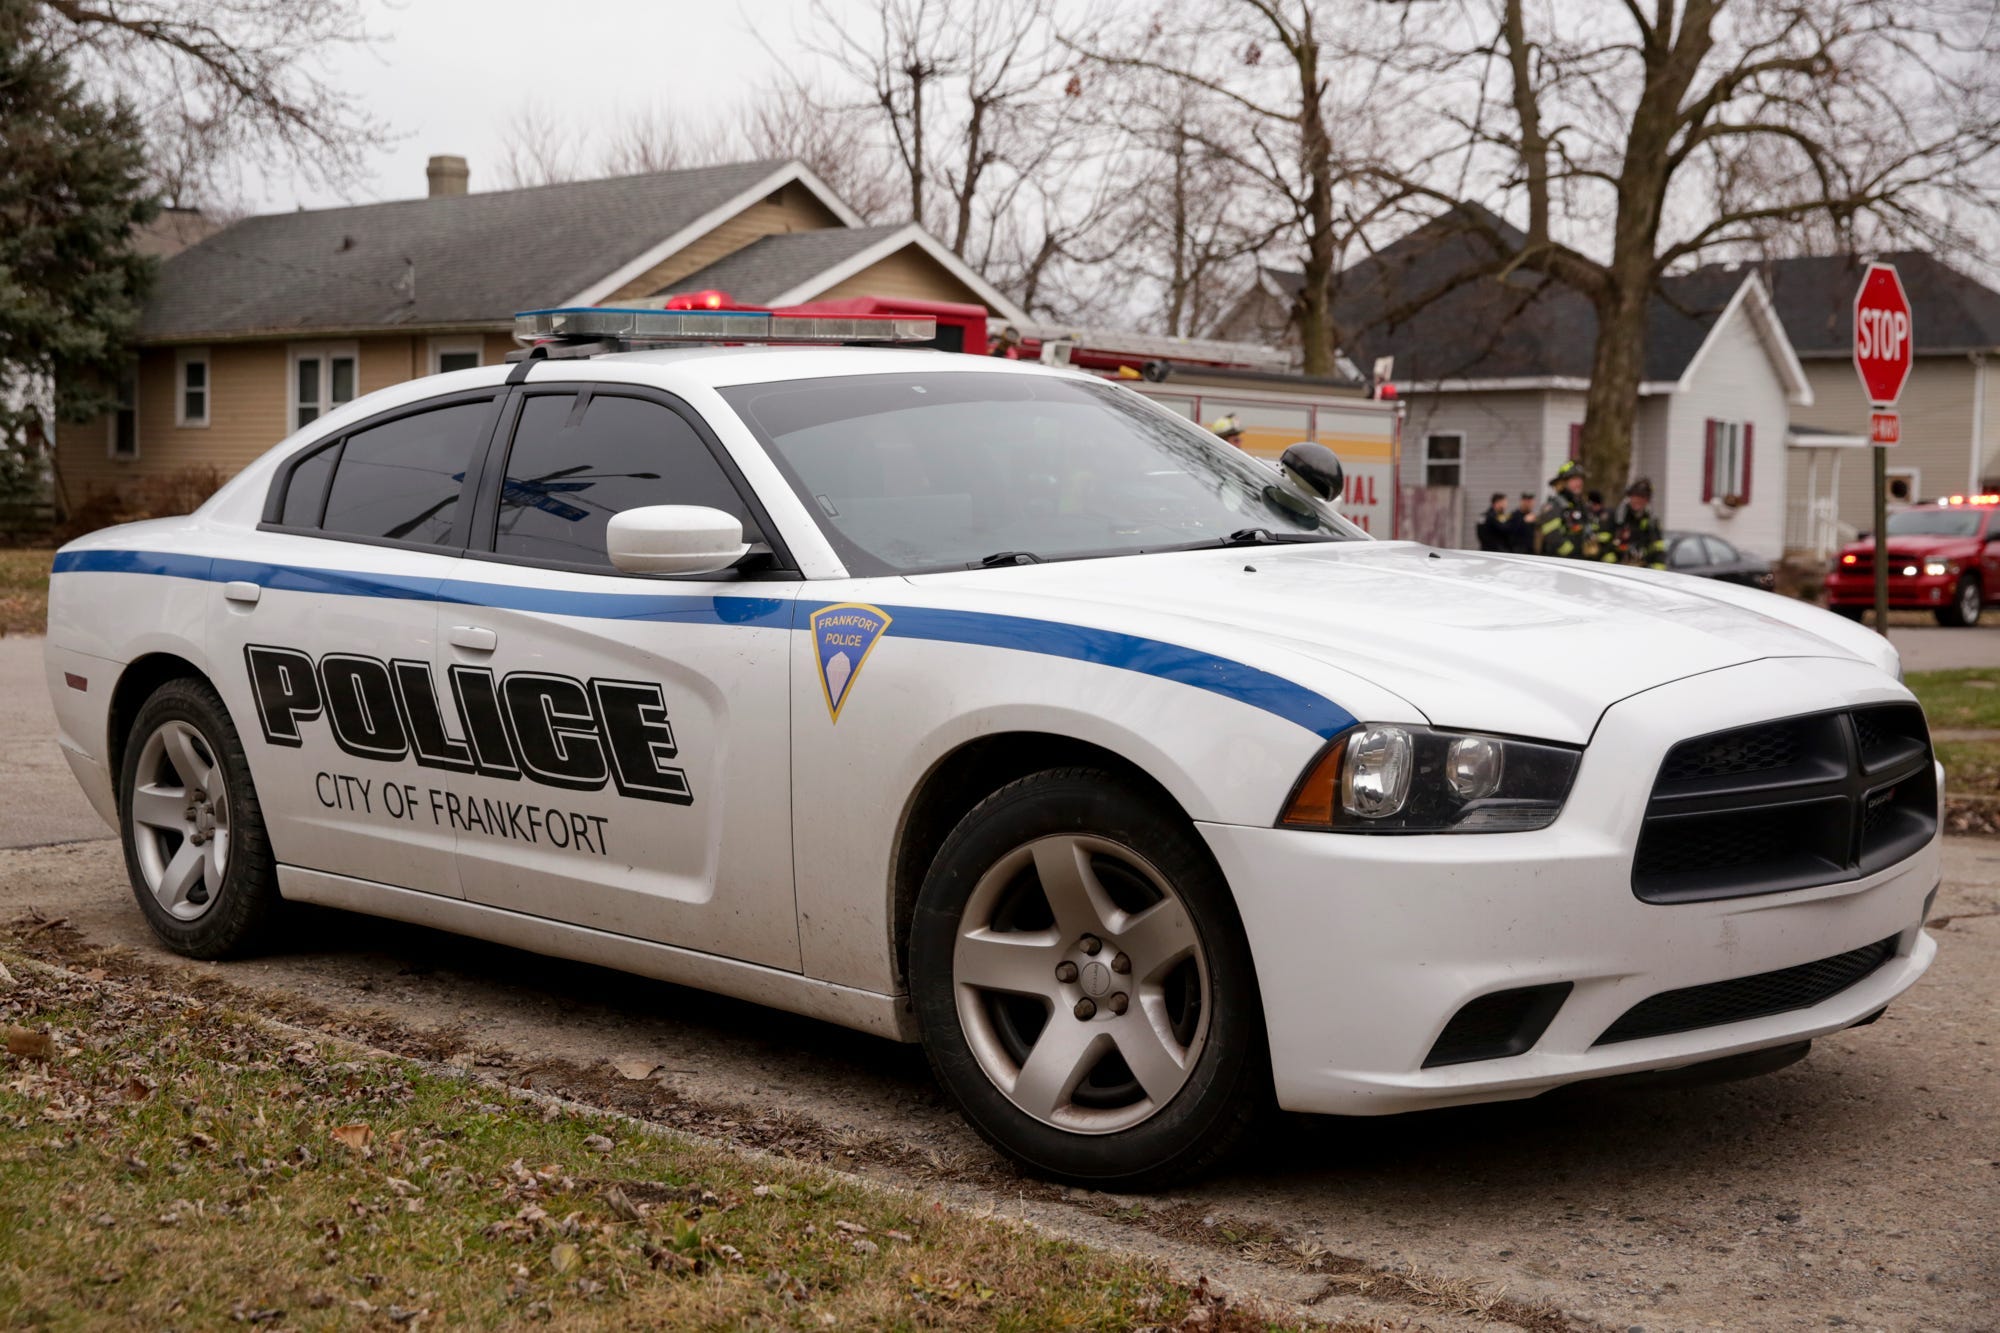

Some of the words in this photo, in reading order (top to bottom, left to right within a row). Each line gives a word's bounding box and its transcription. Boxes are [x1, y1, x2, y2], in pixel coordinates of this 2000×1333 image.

[1859, 307, 1907, 361] STOP
[1344, 475, 1377, 505] IAL
[818, 615, 878, 633] FRANKFORT
[825, 633, 862, 647] POLICE
[243, 643, 694, 807] POLICE
[316, 771, 371, 813] CITY
[383, 782, 420, 821] OF
[430, 789, 608, 856] FRANKFORT
